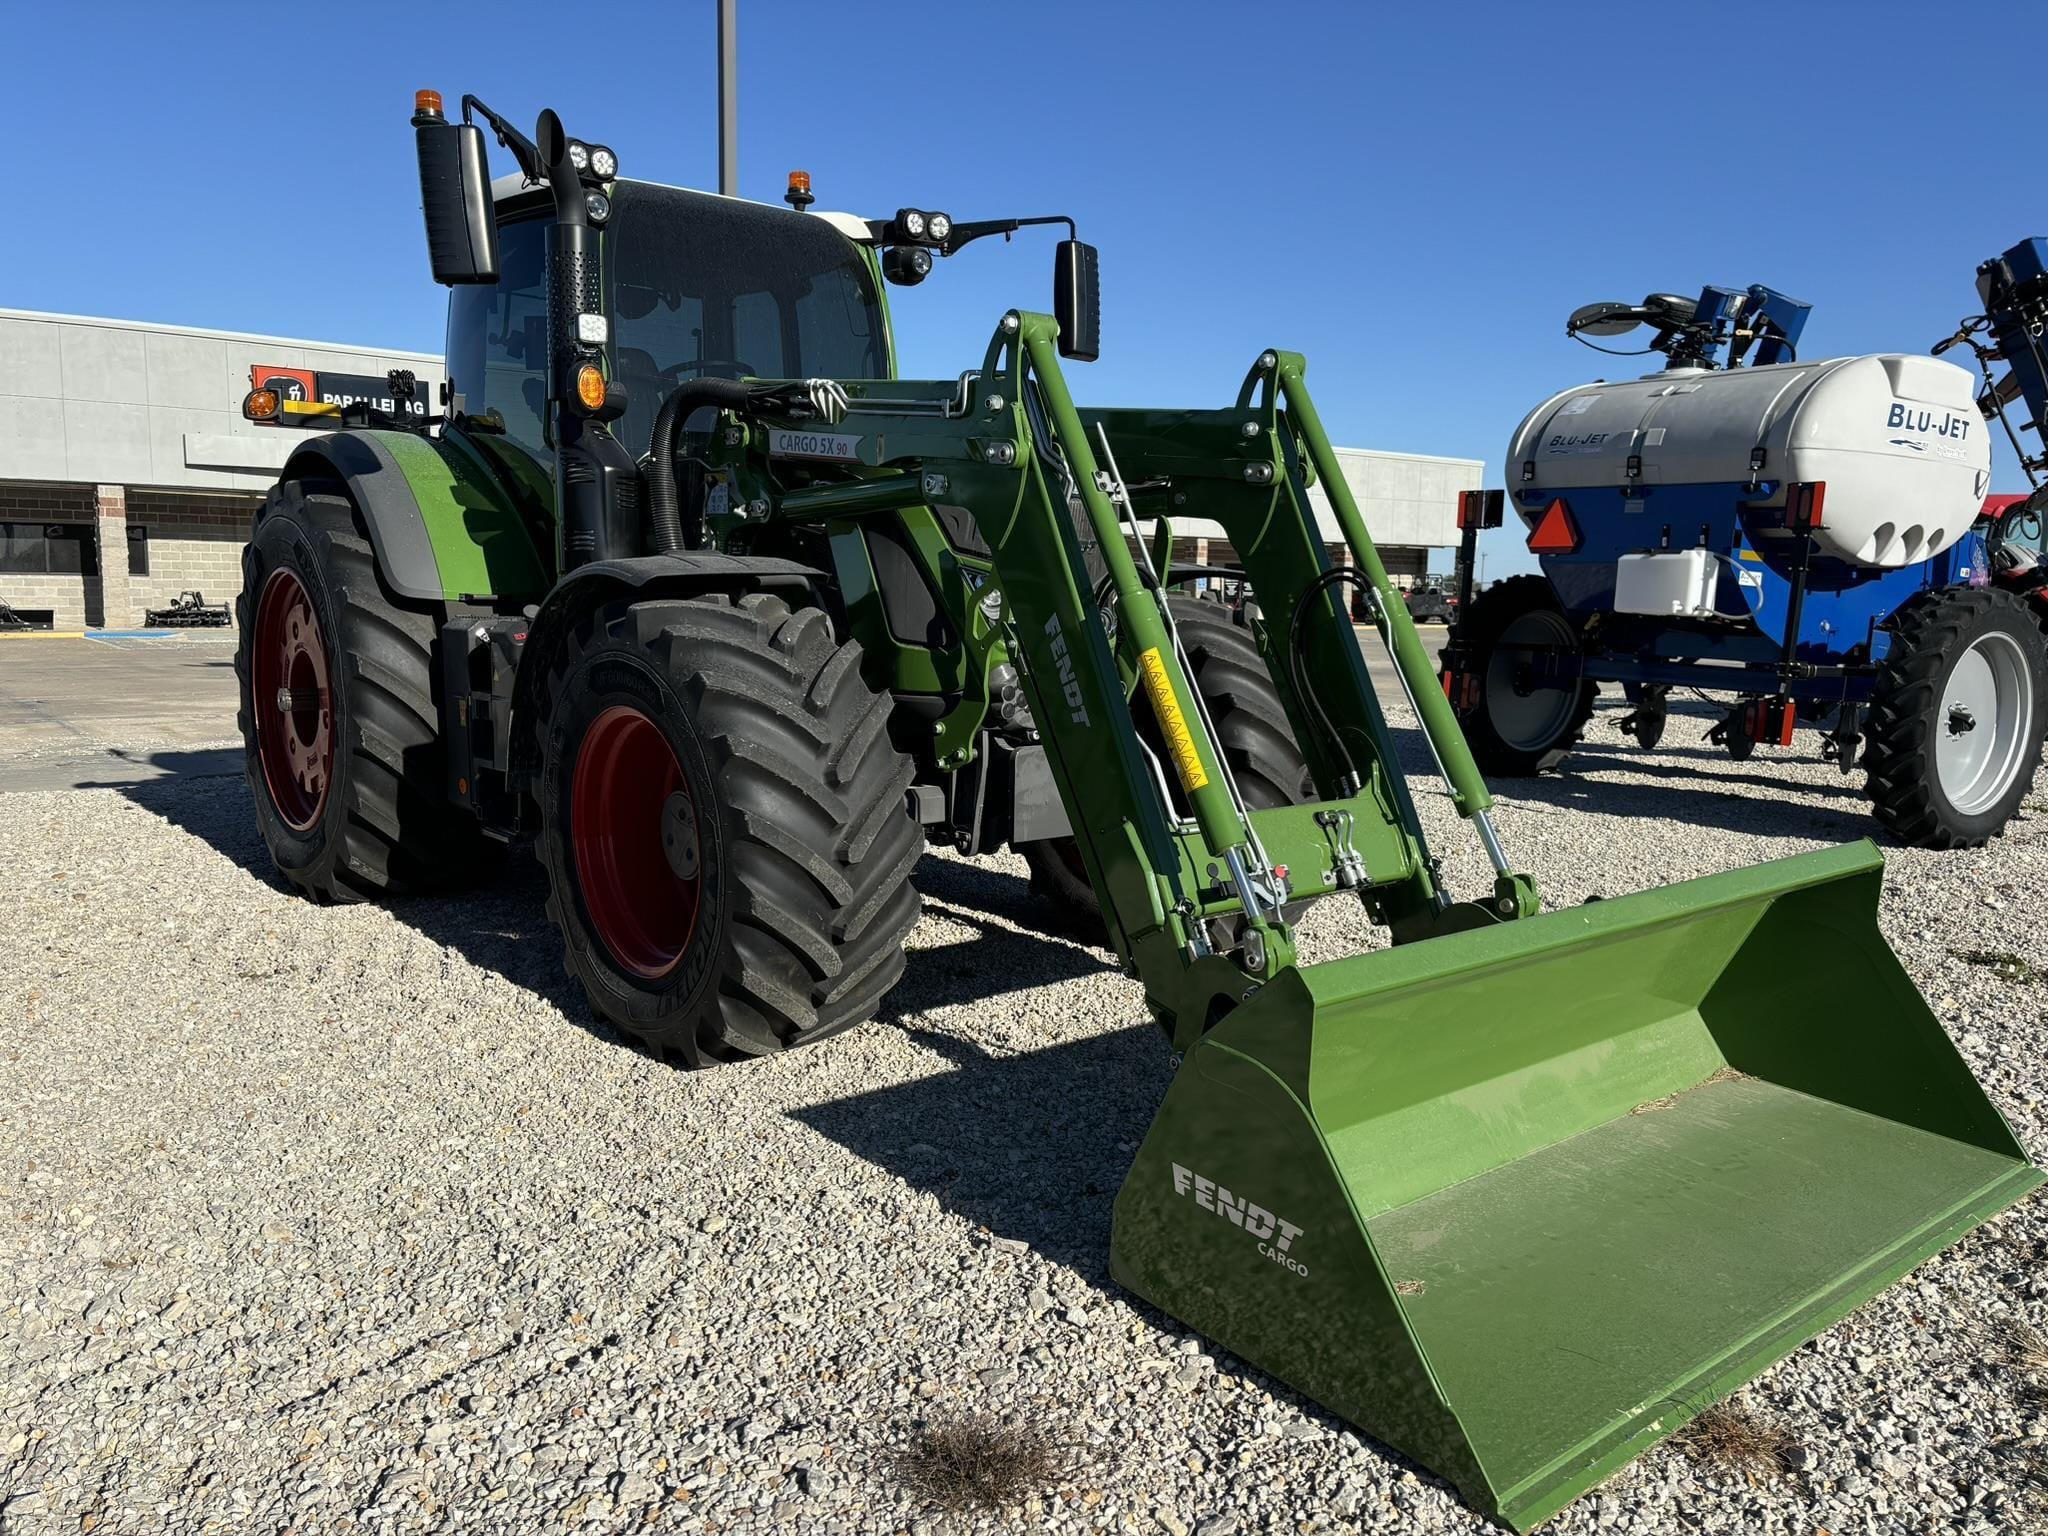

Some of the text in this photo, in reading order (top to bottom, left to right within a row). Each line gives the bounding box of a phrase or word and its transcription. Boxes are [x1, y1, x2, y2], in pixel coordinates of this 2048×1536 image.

[323, 393, 396, 413] PARLEL
[1887, 403, 1970, 440] BLU-JET
[779, 434, 848, 455] CARGO 5X 90
[1549, 432, 1609, 447] BLU-JET
[1044, 612, 1091, 728] FENDT
[1171, 1161, 1305, 1252] FENDT
[1256, 1241, 1309, 1278] CARGO
